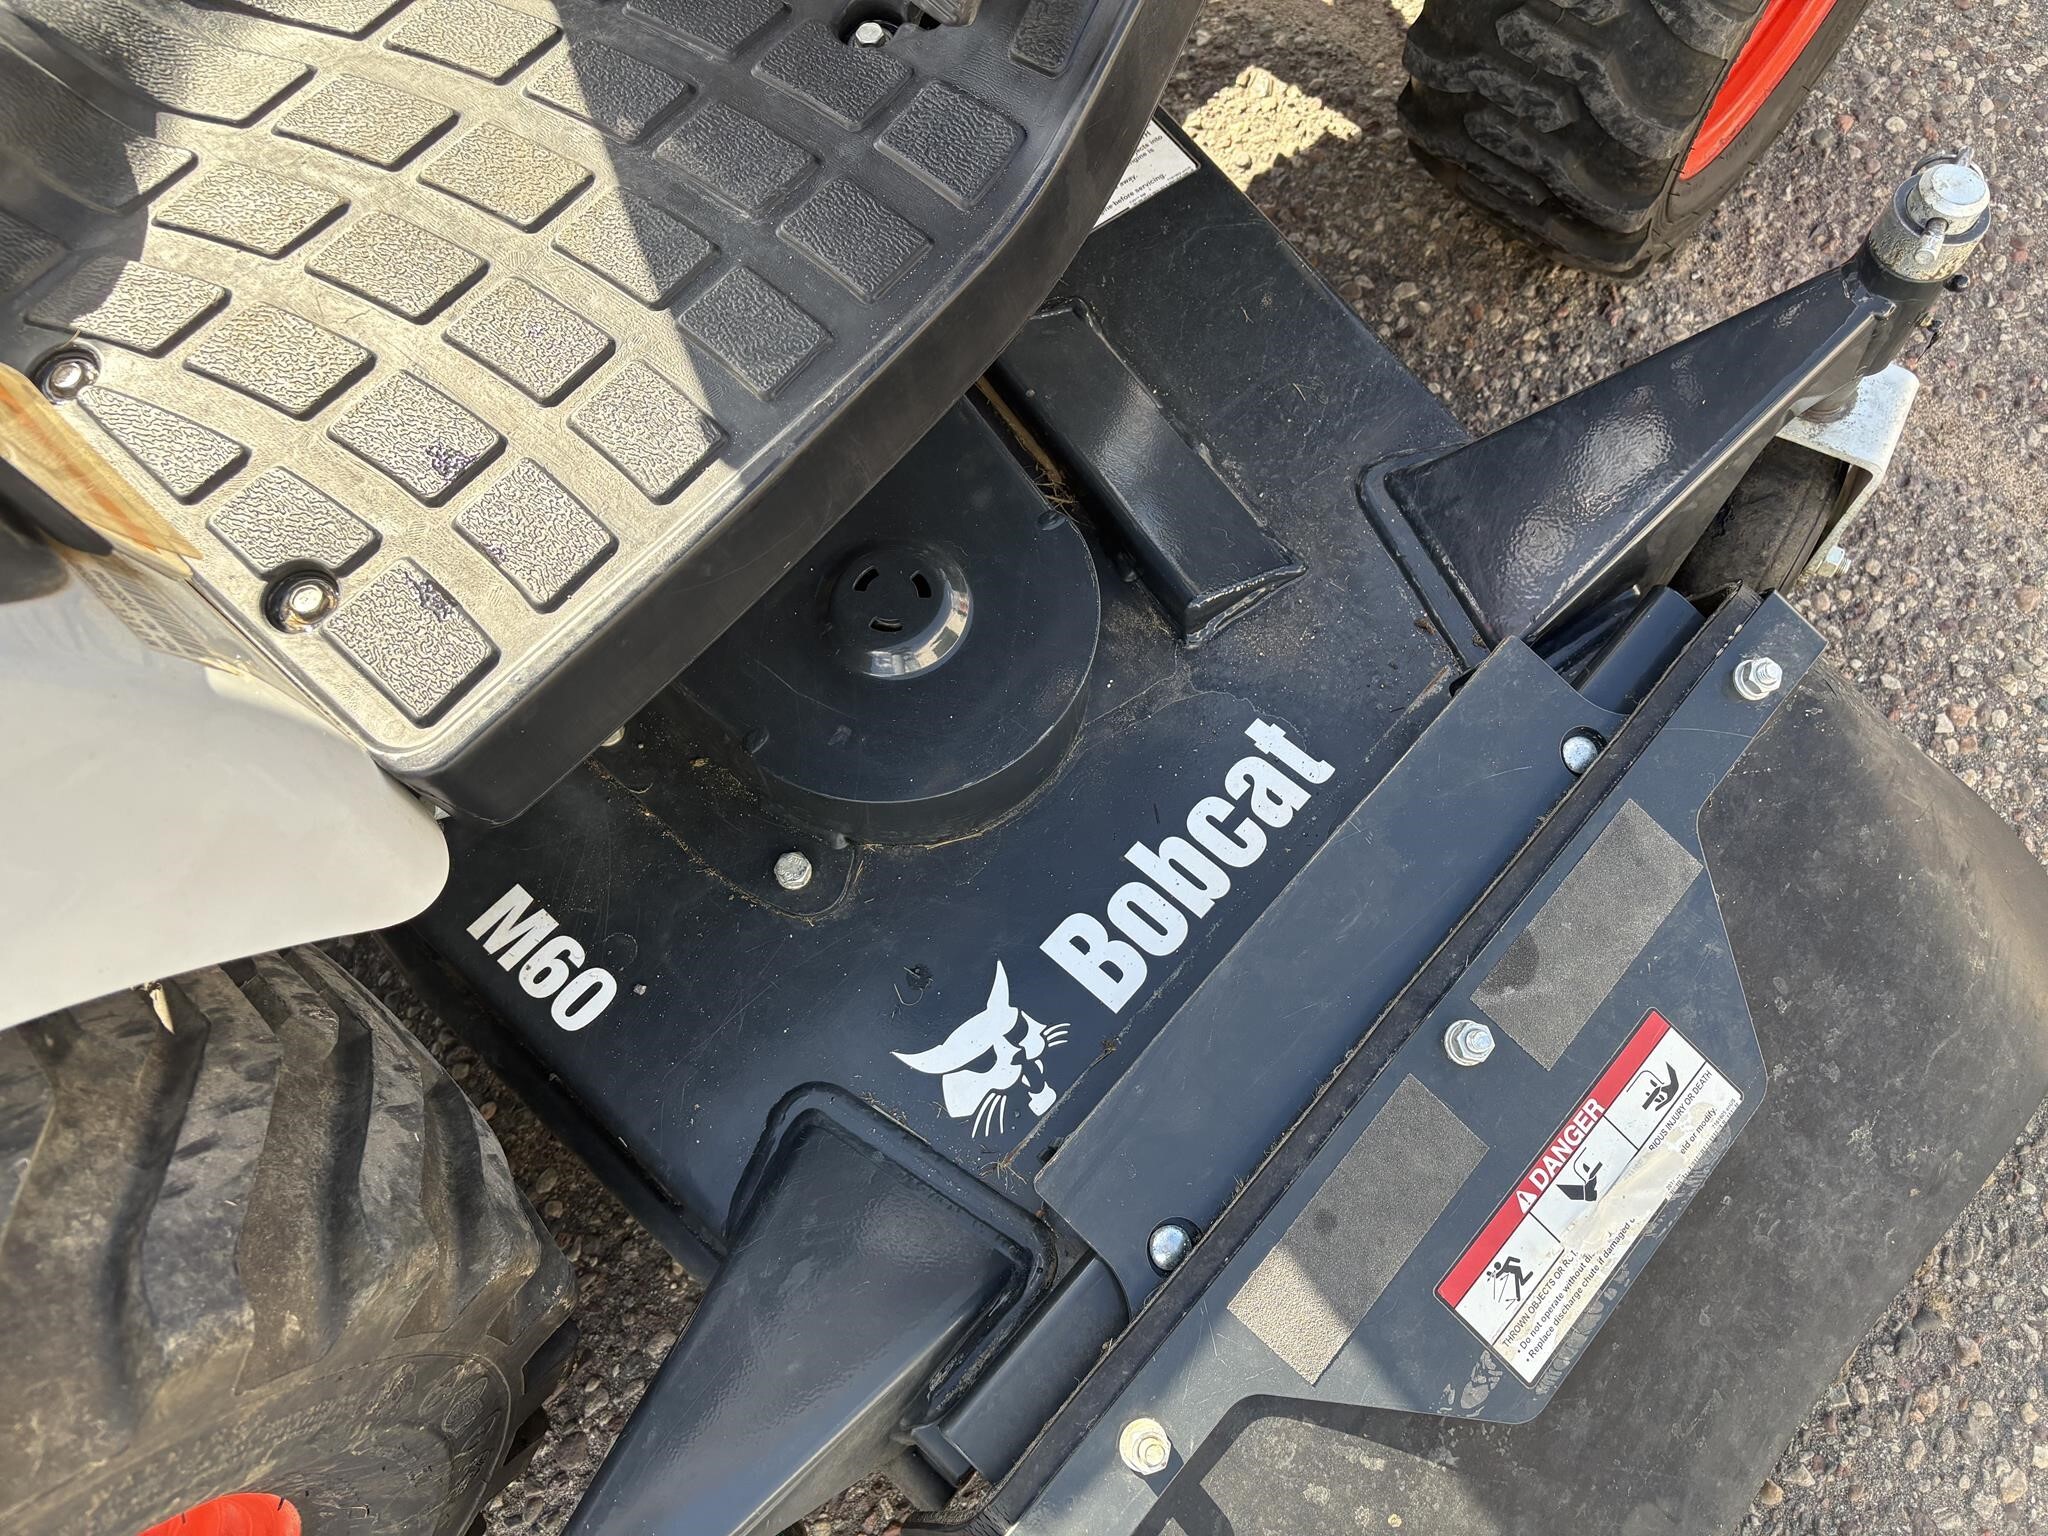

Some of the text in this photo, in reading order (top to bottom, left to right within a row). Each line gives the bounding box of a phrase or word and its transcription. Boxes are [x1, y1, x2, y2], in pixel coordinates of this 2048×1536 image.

[1112, 191, 1135, 206] before
[1134, 173, 1167, 193] servicing.
[1040, 718, 1335, 1013] Bobcat
[467, 884, 617, 1031] M60
[1502, 1313, 1530, 1347] THROWN
[1527, 1278, 1556, 1314] OBJECTS
[1553, 1265, 1566, 1280] OR
[1664, 1103, 1687, 1131] INJURY
[1683, 1092, 1696, 1106] OR
[1691, 1069, 1713, 1095] DEATH
[1528, 1098, 1606, 1192] DANGER
[1519, 1337, 1531, 1350] Do
[1529, 1321, 1543, 1338] not
[1540, 1292, 1564, 1323] operate
[1562, 1262, 1587, 1293] without
[1528, 1326, 1555, 1359] Replace
[1553, 1287, 1583, 1327] discharge
[1581, 1264, 1600, 1288] chute
[1596, 1256, 1605, 1266] if
[1603, 1222, 1631, 1259] damaged
[1689, 1132, 1697, 1143] or
[1695, 1107, 1718, 1134] modify.
